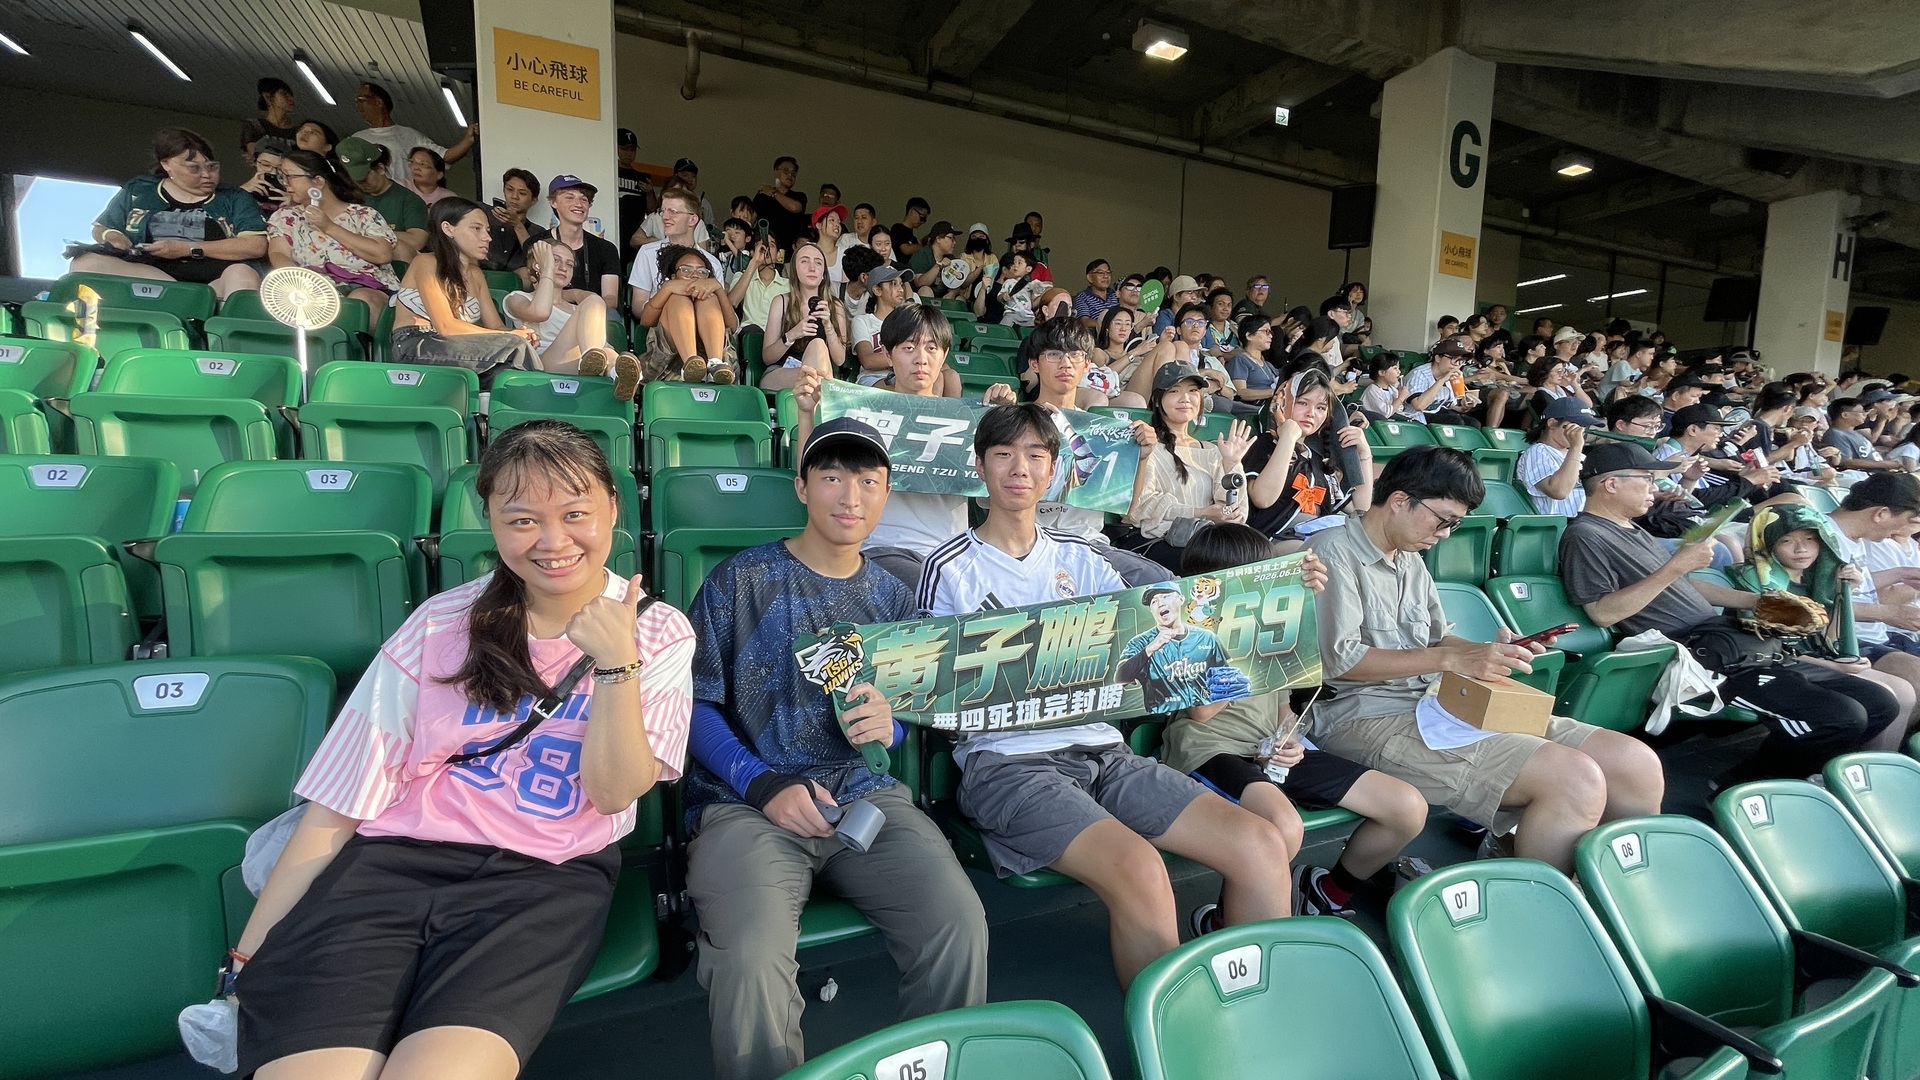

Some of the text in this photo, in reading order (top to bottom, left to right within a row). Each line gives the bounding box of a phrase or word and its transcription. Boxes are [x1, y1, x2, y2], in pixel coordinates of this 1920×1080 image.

[506, 52, 589, 84] 小心飛球
[514, 79, 584, 102] BE CAREFUL
[1449, 120, 1482, 189] G
[1832, 232, 1854, 282] H
[141, 286, 152, 295] 01
[208, 361, 224, 371] 02
[398, 372, 411, 381] 03
[559, 382, 571, 390] 04
[698, 391, 709, 399] 05
[47, 469, 68, 481] 02
[320, 473, 338, 483] 03
[891, 464, 980, 479] SENG TZU YO
[725, 477, 738, 487] 05
[1217, 584, 1305, 661] 69
[822, 657, 848, 679] TSG
[822, 659, 864, 695] HAWKS
[155, 682, 185, 699] 03
[1749, 803, 1759, 816] 09
[1621, 842, 1635, 858] 08
[1454, 891, 1468, 910] 07
[1228, 957, 1248, 980] 06
[899, 1058, 927, 1080] 05
